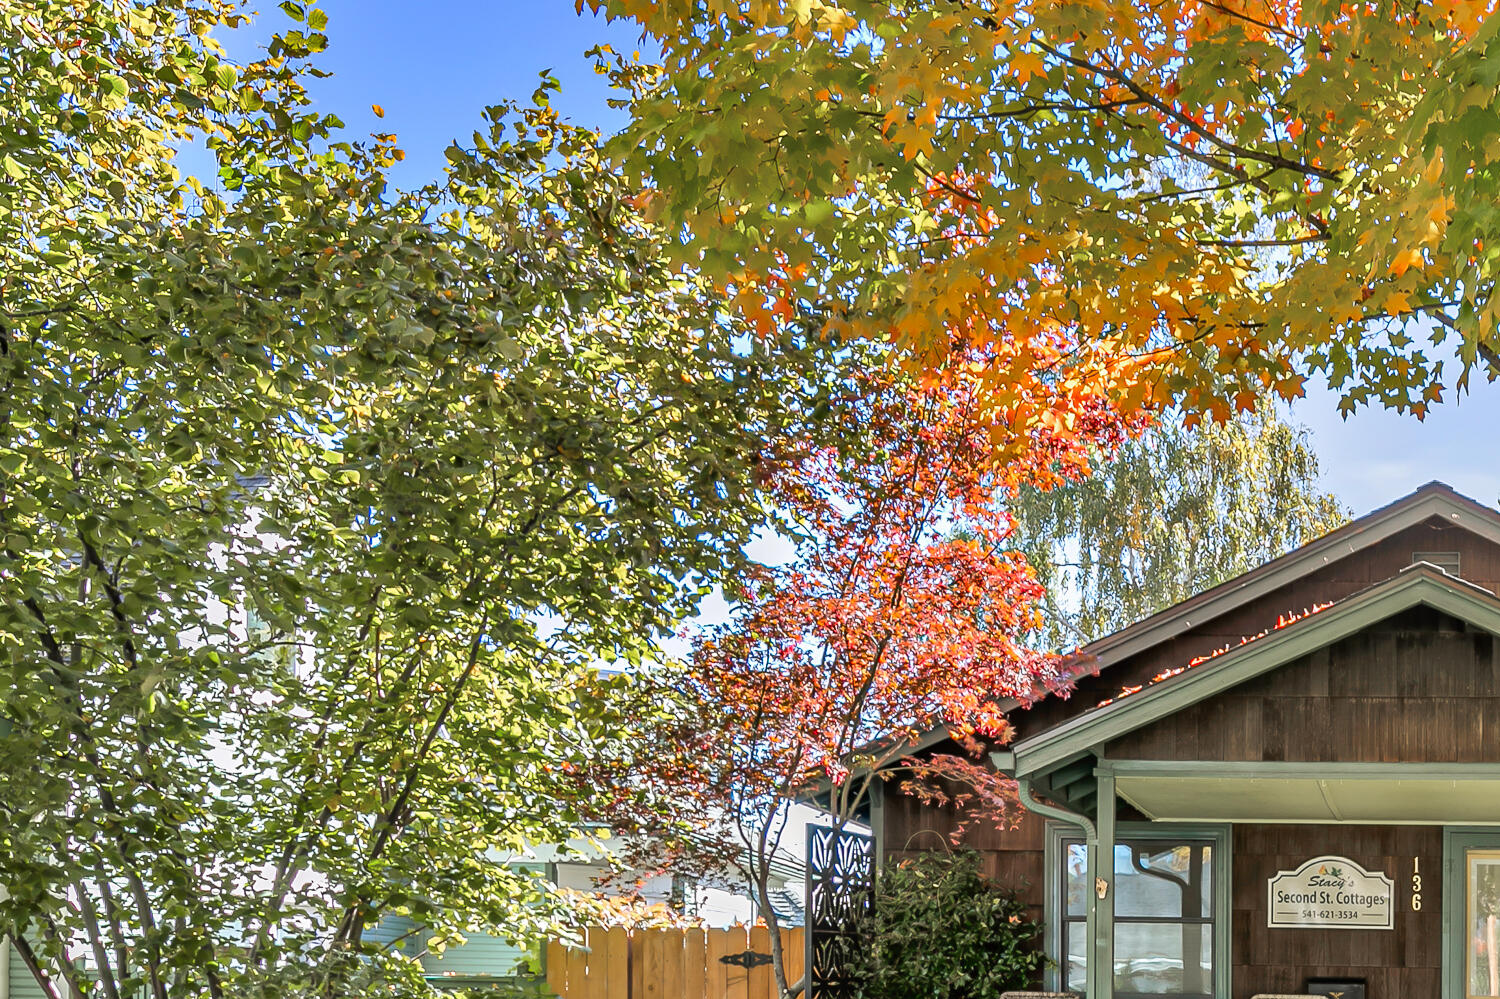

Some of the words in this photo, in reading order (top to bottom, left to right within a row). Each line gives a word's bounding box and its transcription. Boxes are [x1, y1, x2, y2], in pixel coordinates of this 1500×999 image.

[1308, 875, 1354, 890] Stacy's
[1412, 856, 1422, 912] 136
[1277, 890, 1316, 904] Second
[1320, 891, 1334, 904] St.
[1336, 891, 1385, 908] Cottages
[1302, 910, 1358, 919] 541-621-3534
